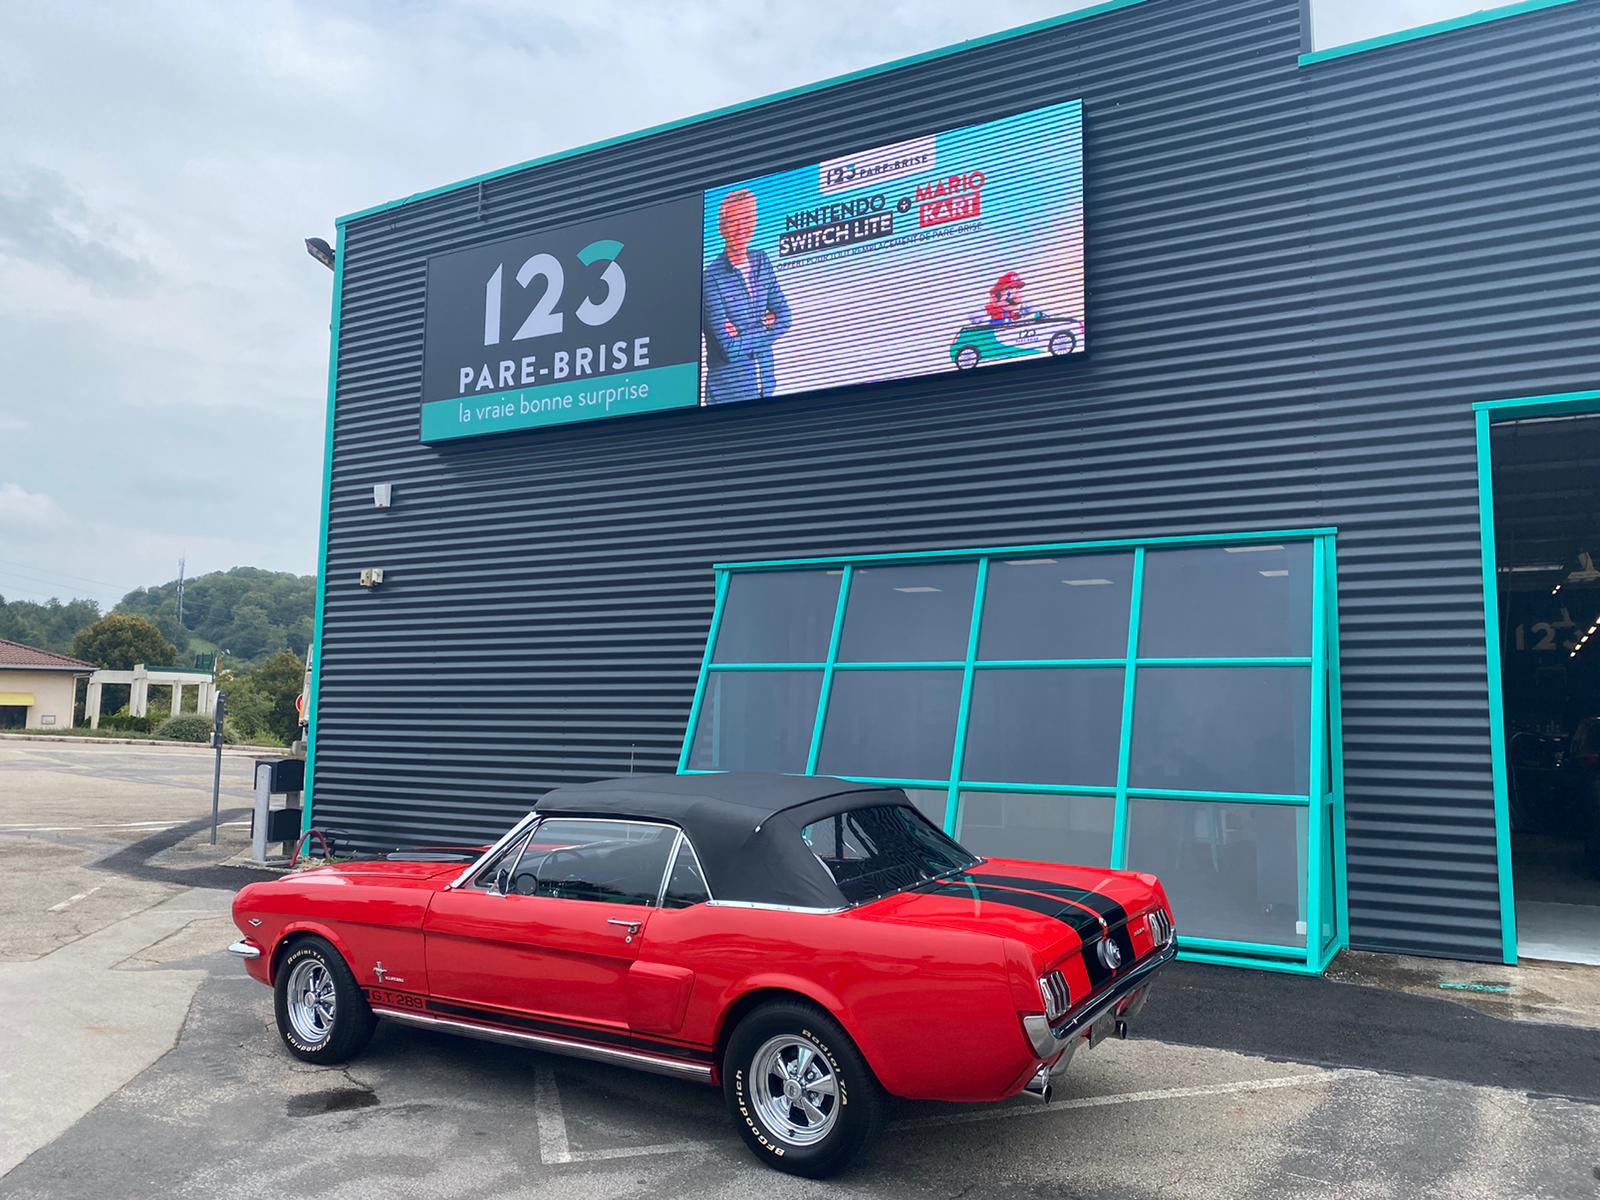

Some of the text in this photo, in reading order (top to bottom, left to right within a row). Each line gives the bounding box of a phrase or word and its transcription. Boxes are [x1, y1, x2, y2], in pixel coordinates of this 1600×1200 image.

[827, 164, 856, 185] 123
[915, 171, 986, 202] MARIO
[785, 193, 885, 231] NINTENDO
[923, 195, 976, 224] KART
[780, 213, 893, 255] SWITCH LITE
[484, 239, 626, 346] 123
[459, 336, 650, 393] PARE-BRISE
[459, 379, 649, 423] la vraie bonne surprise
[287, 950, 311, 965] Radial
[396, 993, 424, 1009] 289
[802, 1028, 841, 1073] Radial
[735, 1069, 786, 1157] BFGoodrich
